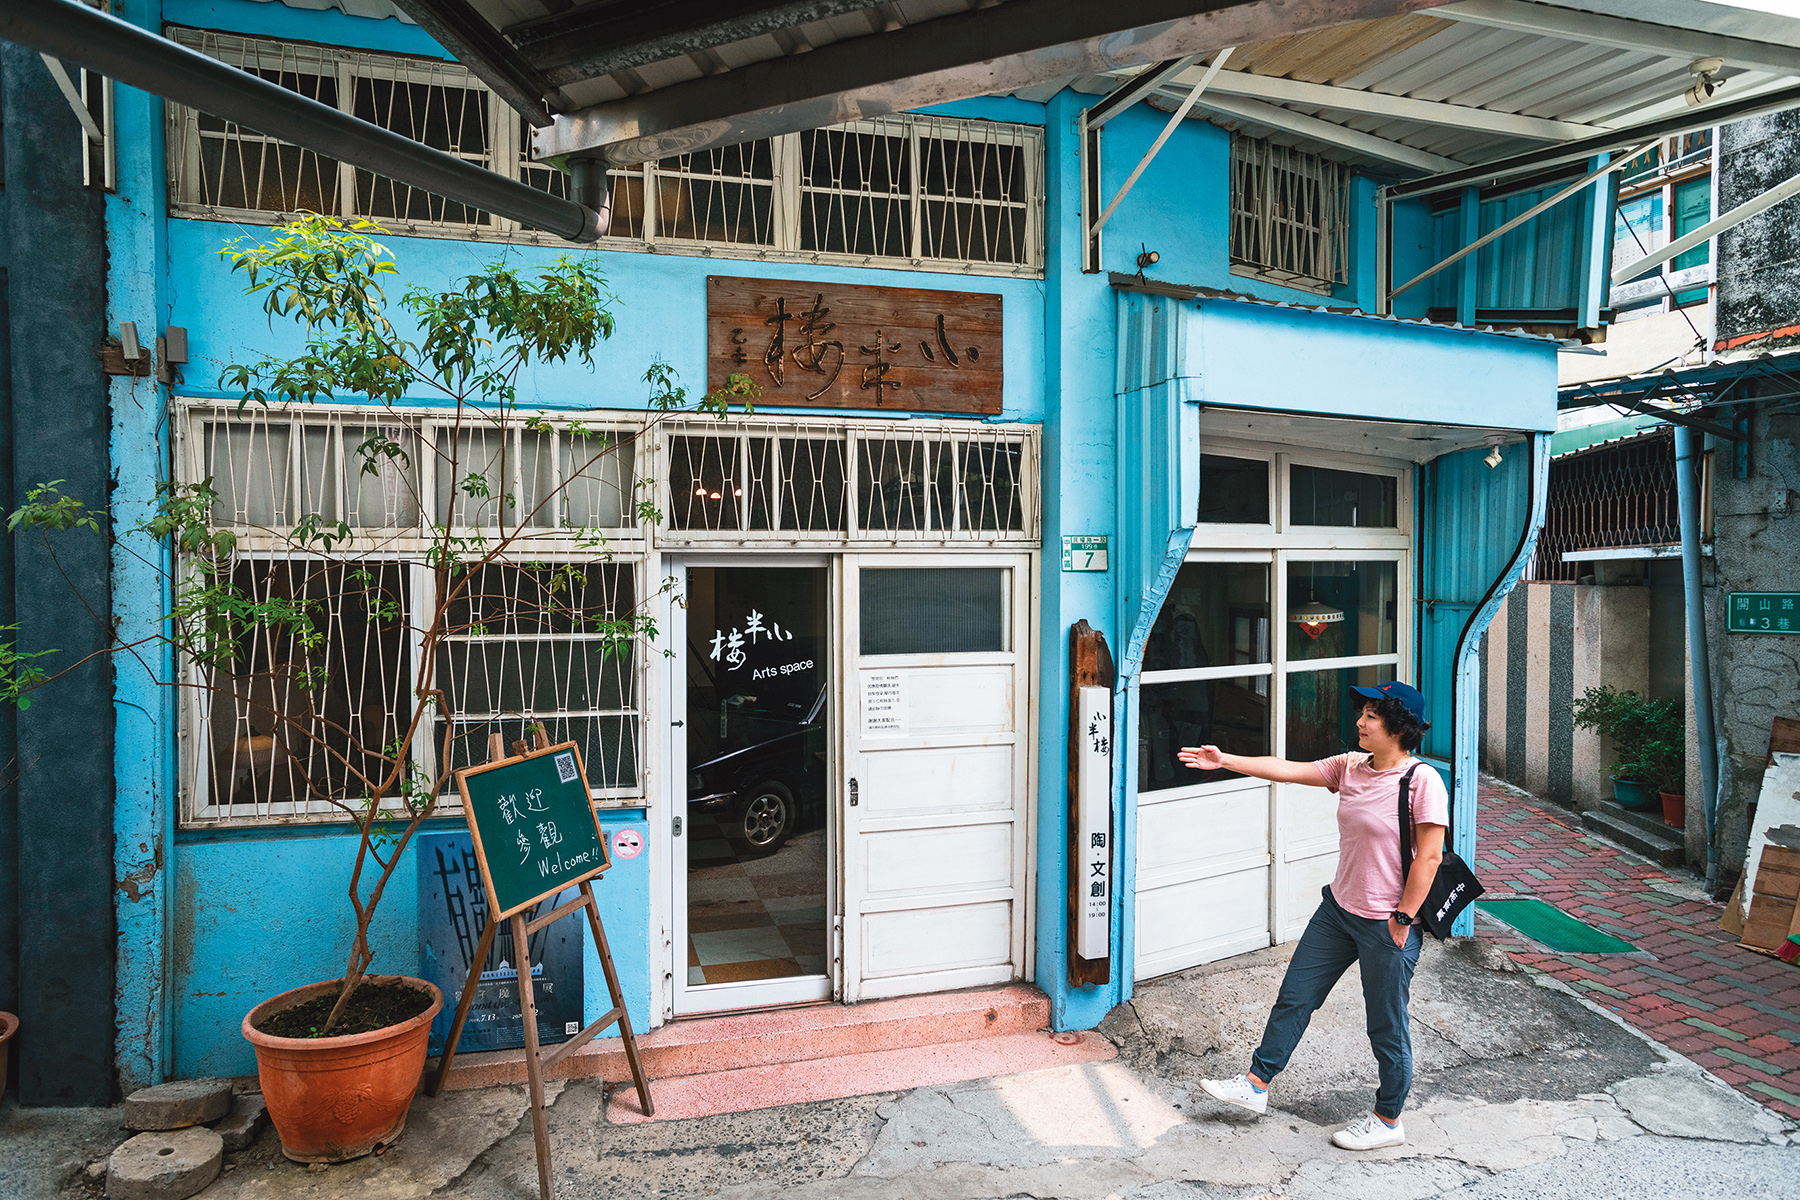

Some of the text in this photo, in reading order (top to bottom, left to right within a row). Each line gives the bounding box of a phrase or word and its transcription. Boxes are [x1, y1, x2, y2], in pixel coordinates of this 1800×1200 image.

[1085, 552, 1094, 568] 7
[1737, 597, 1795, 611] 開山路
[709, 608, 794, 672] 小半樓
[752, 659, 815, 681] Arts space
[1088, 711, 1110, 757] 小半樓
[497, 788, 550, 825] 歡迎
[516, 821, 563, 866] 參觀
